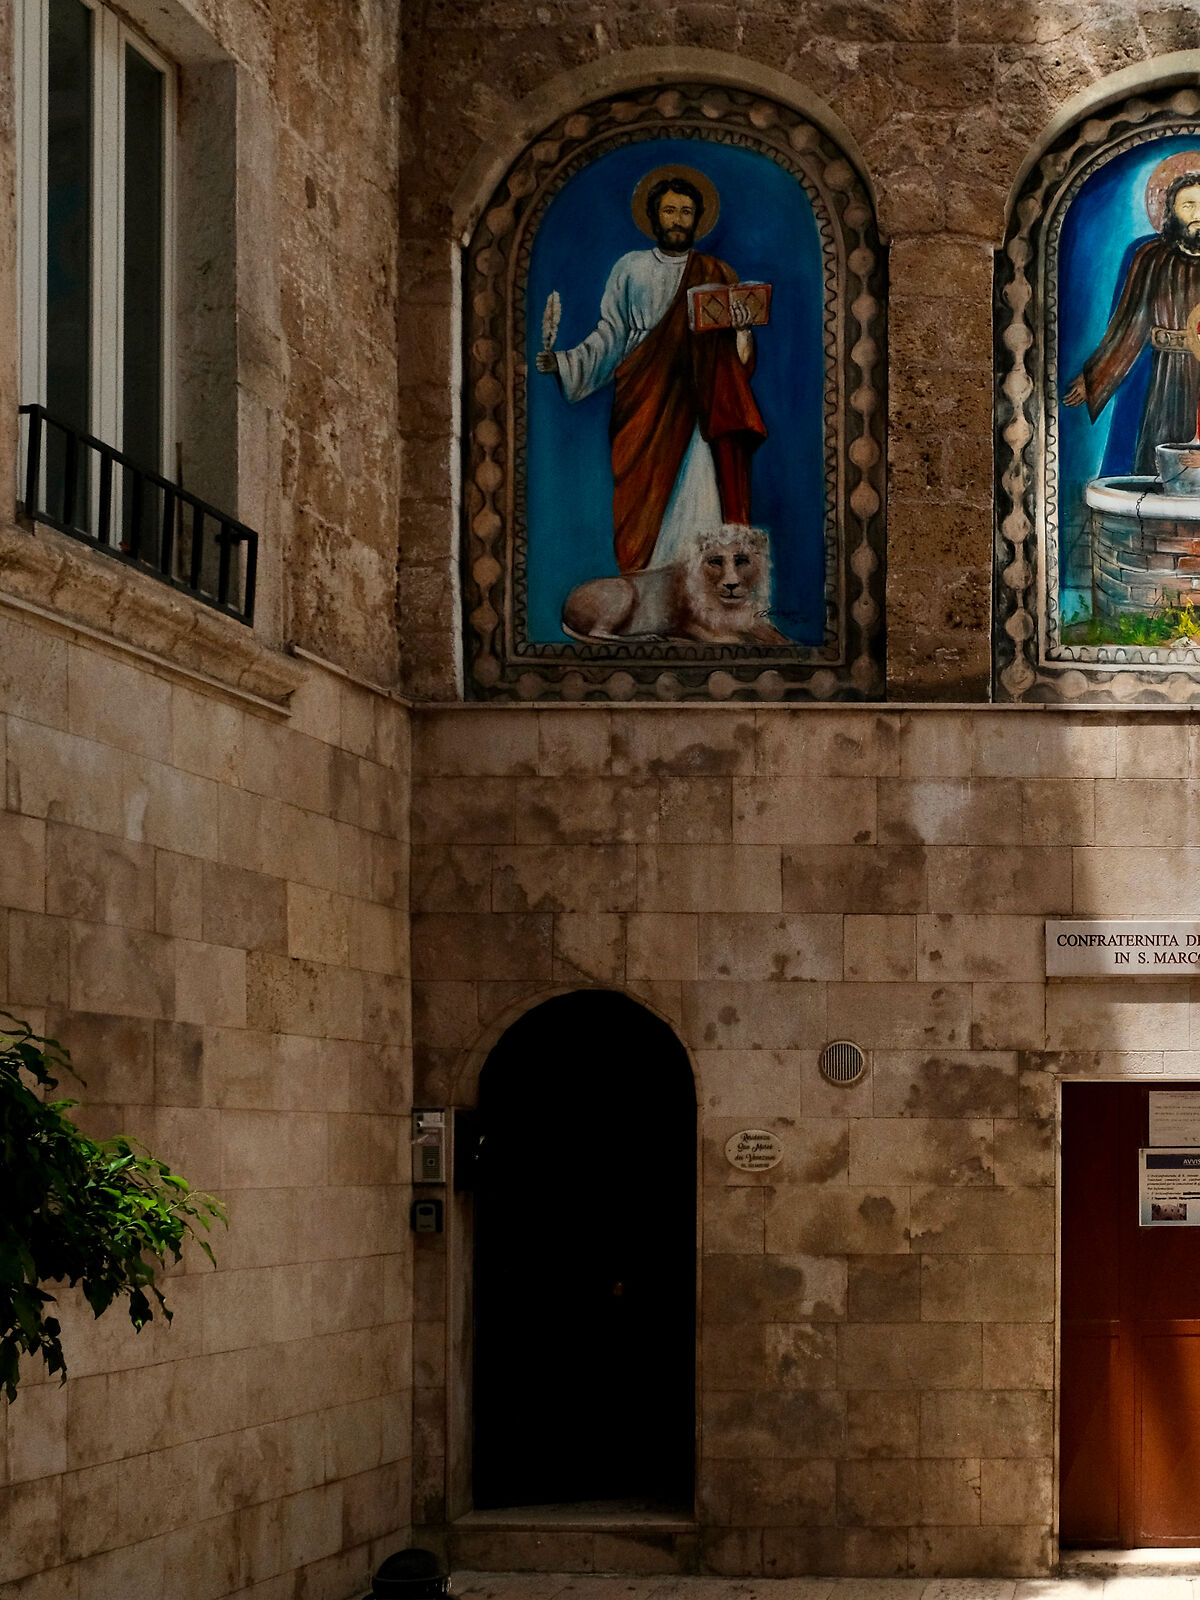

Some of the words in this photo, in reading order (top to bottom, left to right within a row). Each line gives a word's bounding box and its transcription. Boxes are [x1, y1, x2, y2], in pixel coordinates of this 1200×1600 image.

[1057, 934, 1179, 947] CONFRATERNITA
[1115, 951, 1130, 964] IN
[1138, 951, 1150, 964] S.
